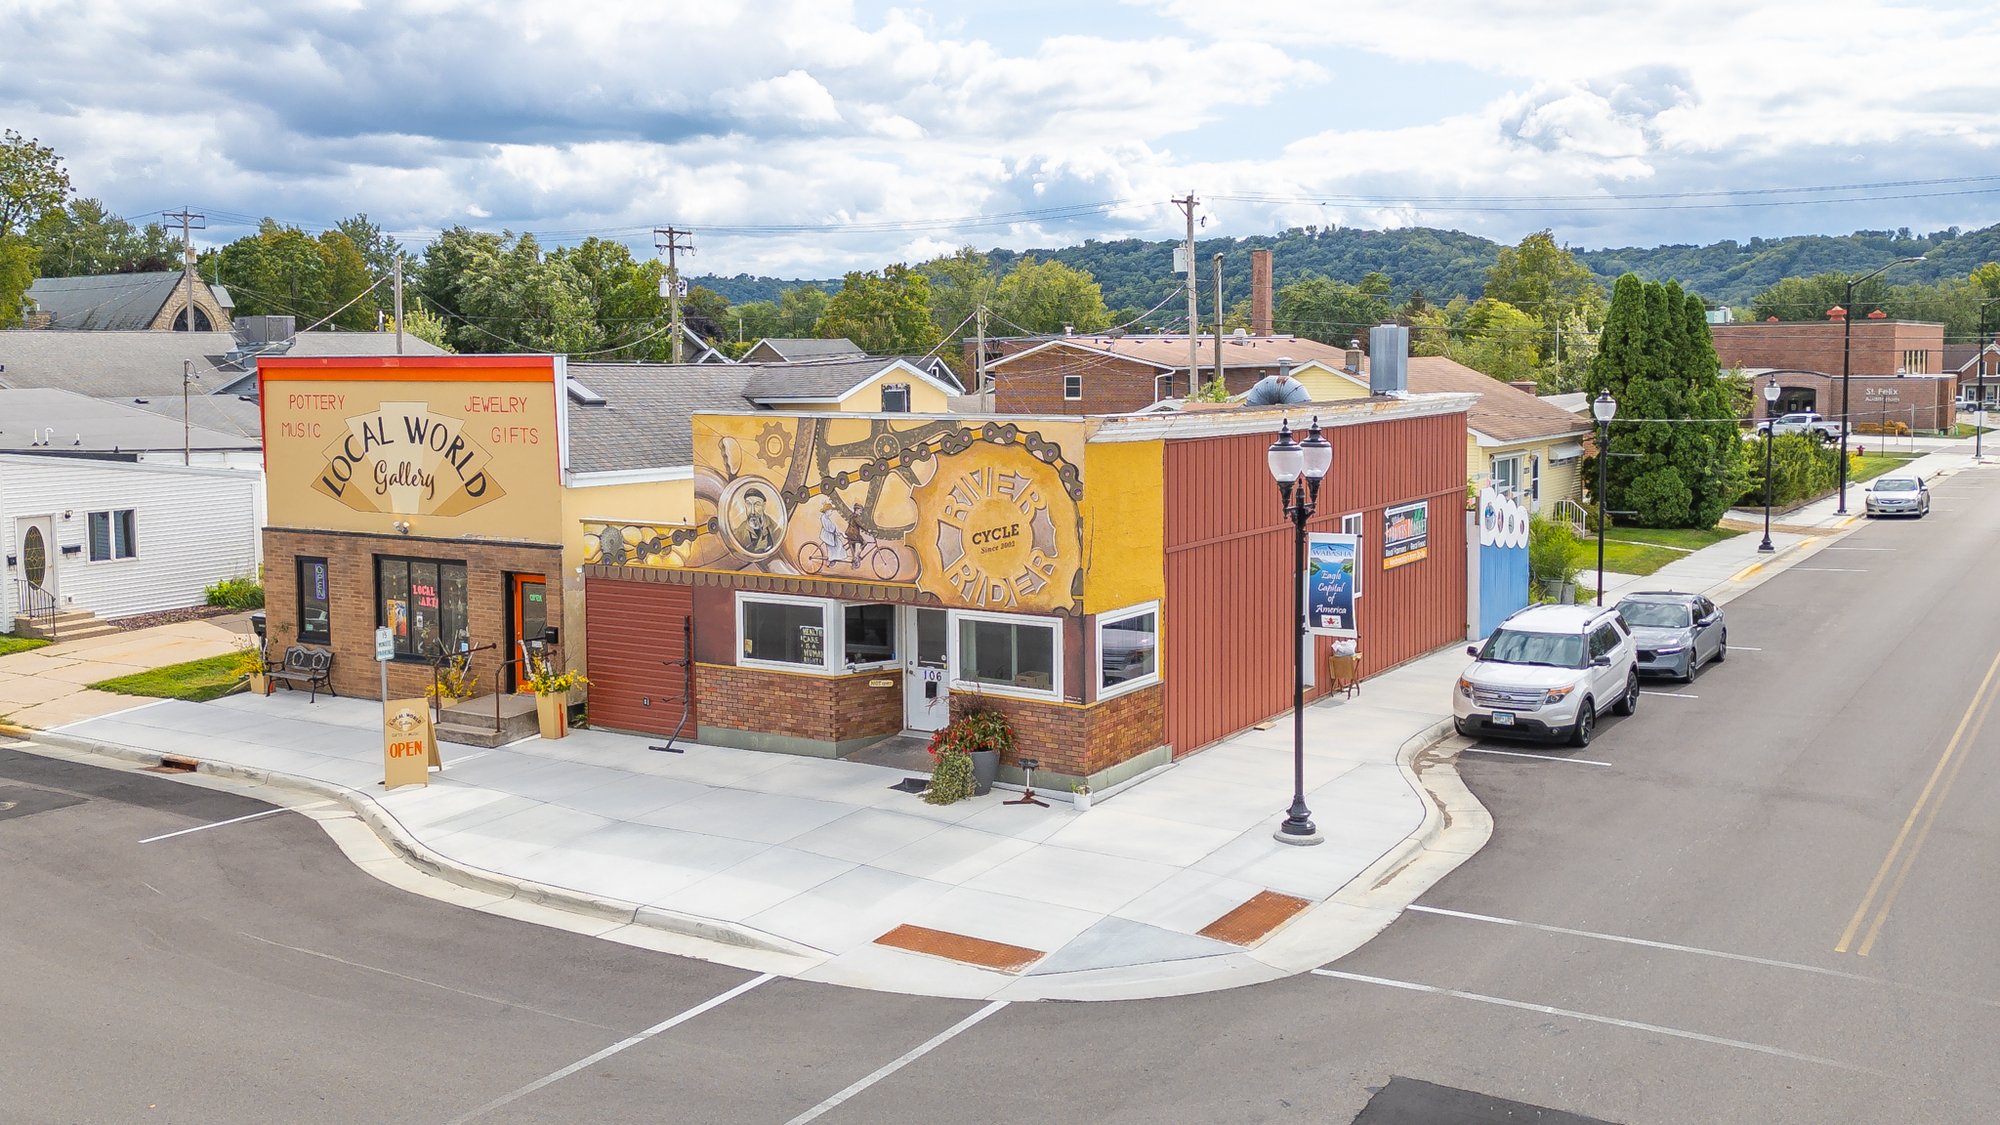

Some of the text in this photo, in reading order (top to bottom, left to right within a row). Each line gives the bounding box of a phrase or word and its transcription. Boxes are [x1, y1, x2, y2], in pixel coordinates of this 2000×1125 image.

[289, 393, 345, 411] POTTERY
[464, 395, 528, 413] JEWELRY
[281, 422, 321, 439] MUSIC
[491, 426, 539, 445] GIFTS
[322, 415, 487, 498] LOCAL WORLD
[374, 459, 435, 500] Gallery
[940, 466, 1048, 529] RIVER
[972, 523, 1020, 545] CYCLE
[980, 546, 999, 554] Since
[1312, 549, 1353, 558] WABASHA
[943, 547, 1058, 608] RIDER
[1321, 569, 1341, 584] Eagle
[412, 584, 436, 597] LOCAL
[1318, 582, 1345, 595] Capital
[1327, 593, 1336, 605] of
[1315, 604, 1347, 614] America
[923, 670, 942, 682] 106
[406, 712, 422, 724] WORLD
[389, 740, 422, 758] OPEN
